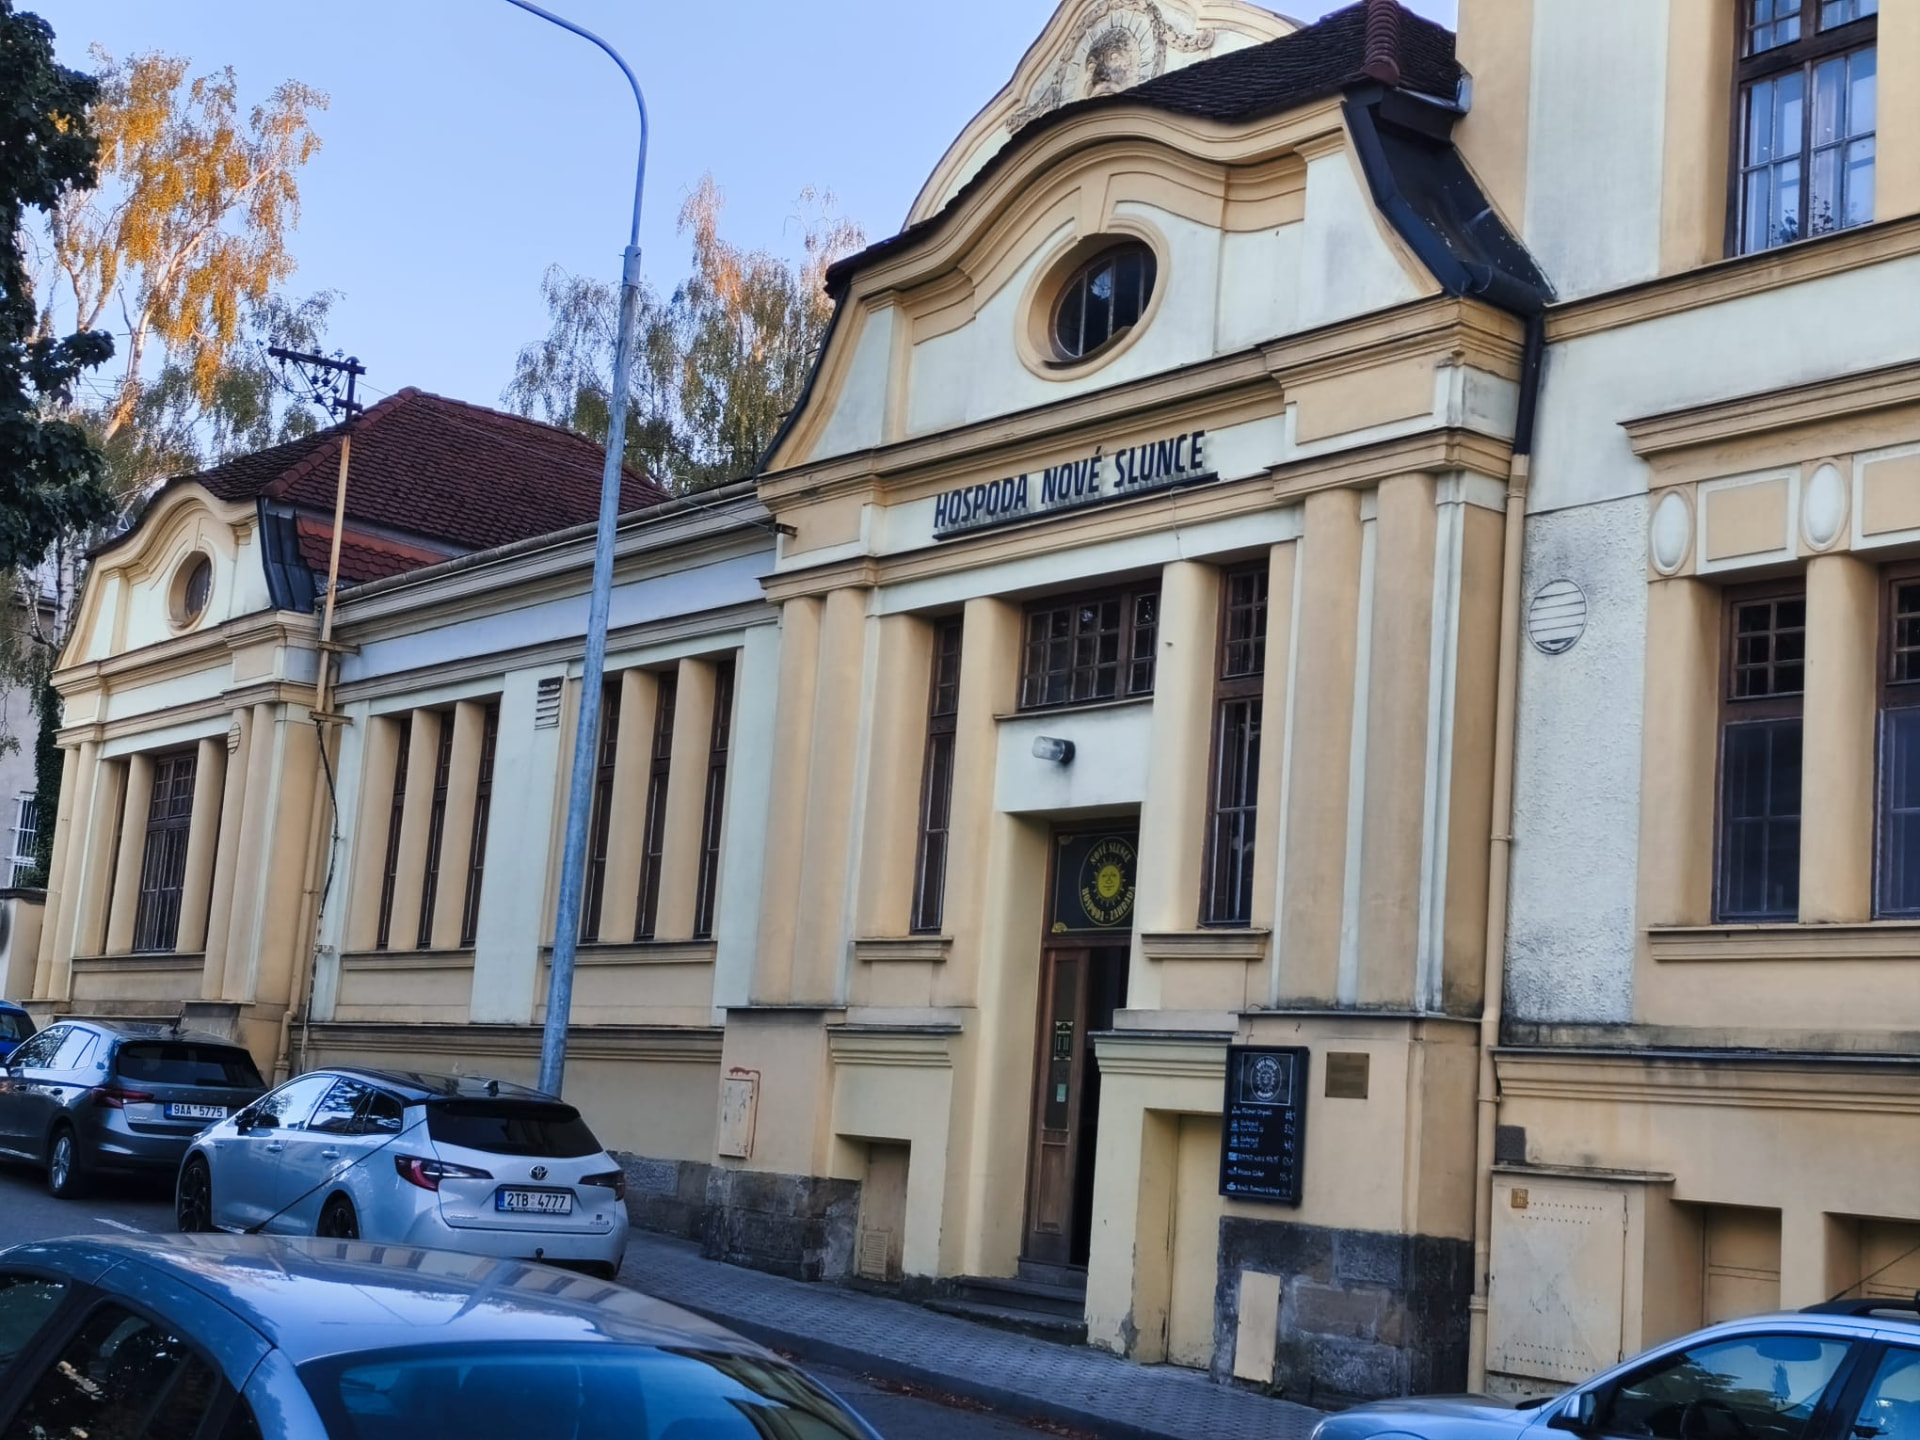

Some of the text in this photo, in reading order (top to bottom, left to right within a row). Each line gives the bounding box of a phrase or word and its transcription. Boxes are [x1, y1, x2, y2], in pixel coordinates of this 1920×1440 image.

[934, 430, 1206, 528] HOSPODA NOVÉ SLUNCE
[174, 1104, 223, 1118] 9AA 5775
[507, 1192, 529, 1207] 2TB
[538, 1194, 567, 1209] 4777
